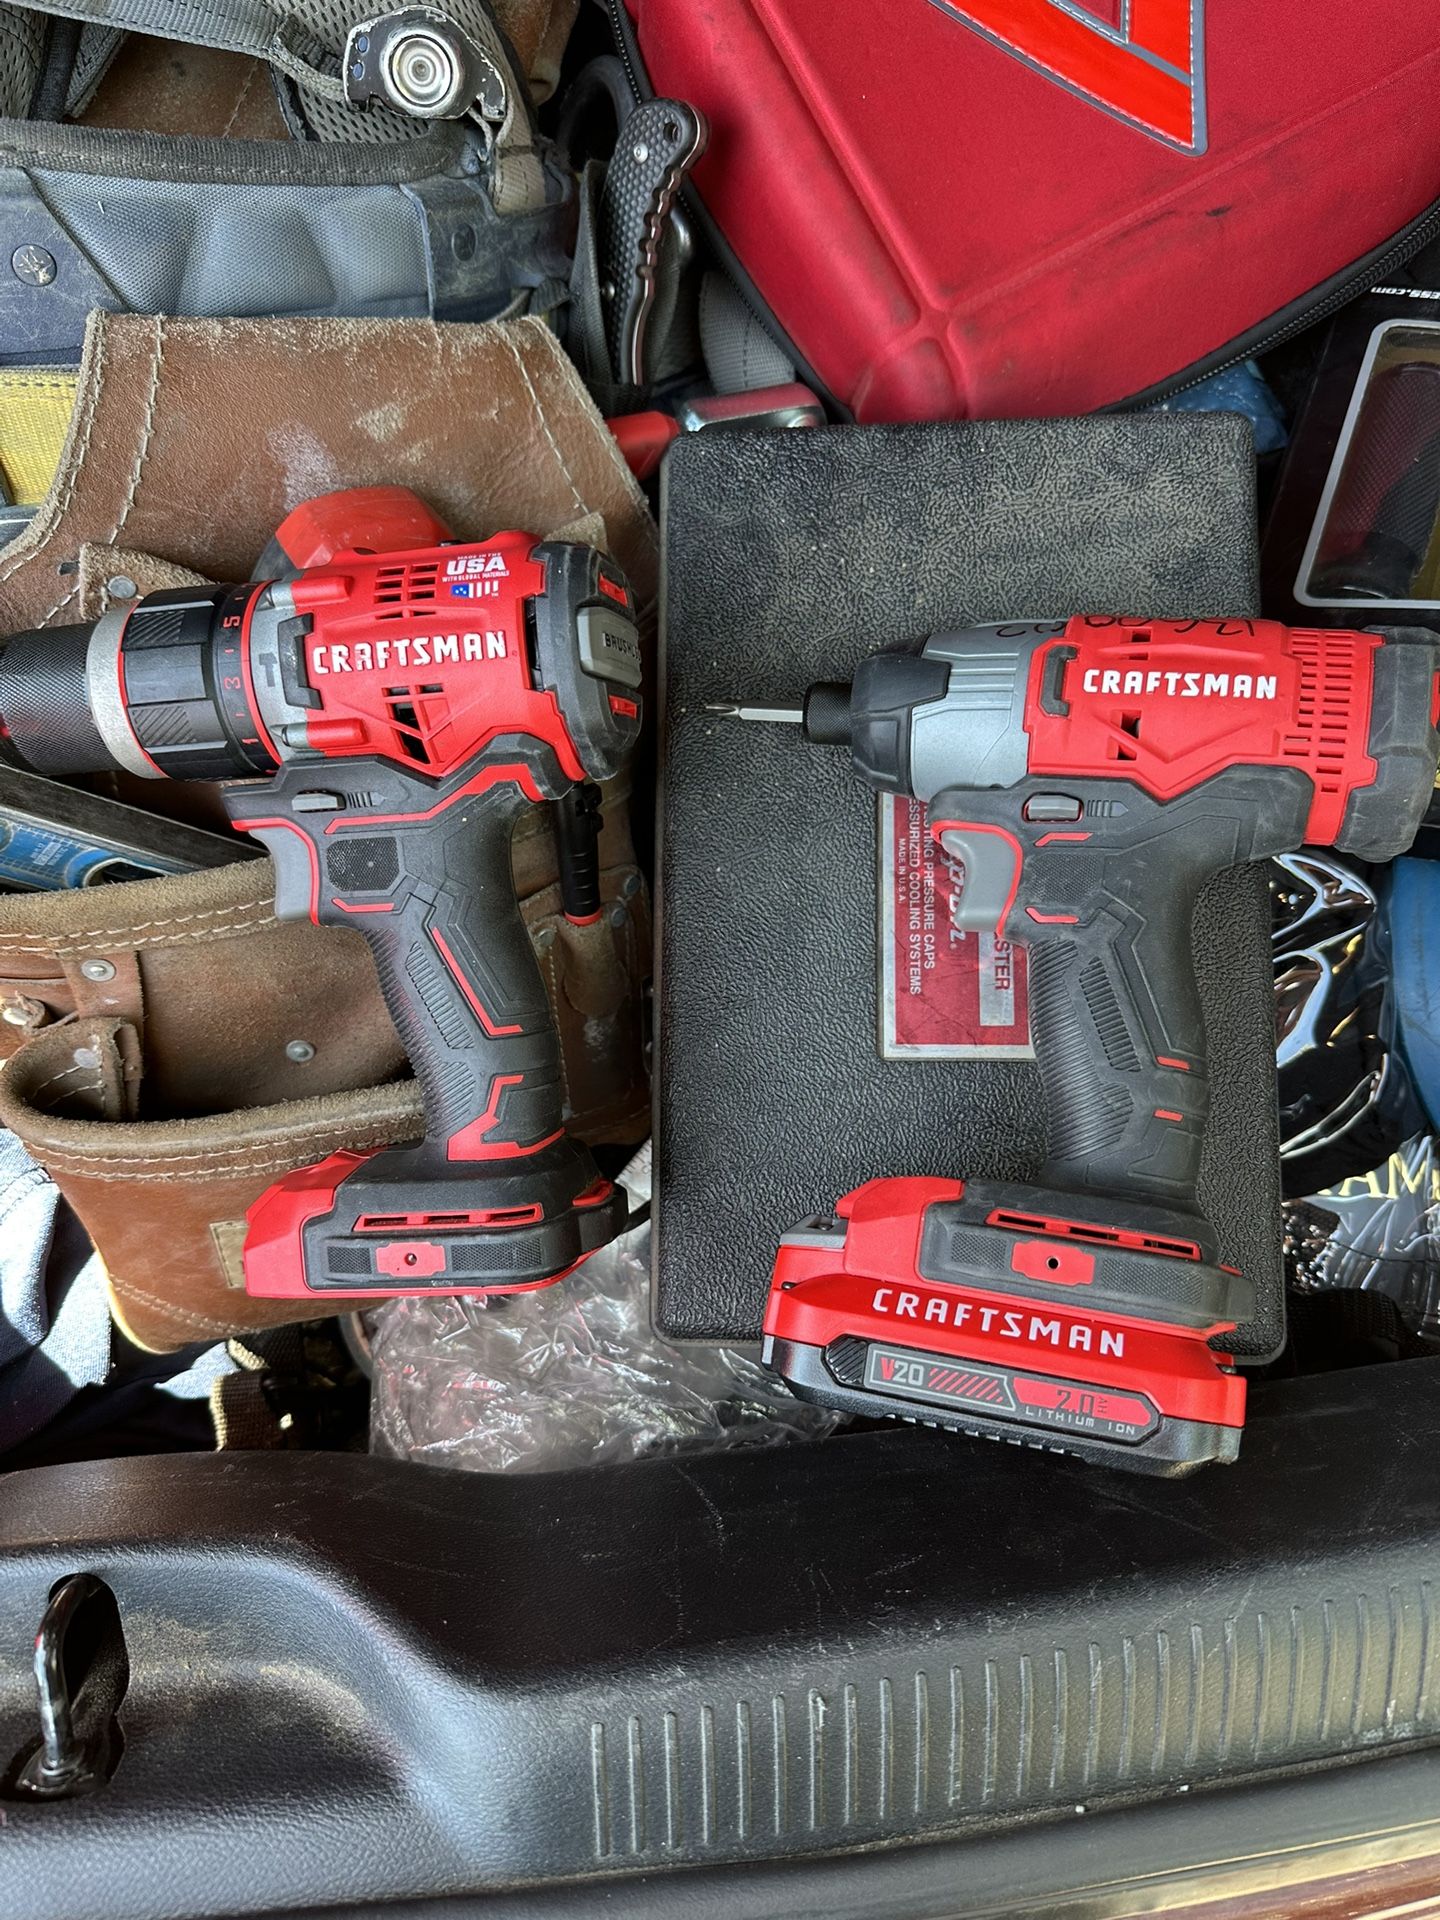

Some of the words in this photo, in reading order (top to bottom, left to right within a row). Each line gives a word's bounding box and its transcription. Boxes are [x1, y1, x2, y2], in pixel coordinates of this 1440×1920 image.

[441, 575, 458, 583] WITH
[458, 573, 481, 581] GLOBAL
[481, 570, 510, 579] MATERIALS
[446, 556, 507, 576] USA
[222, 615, 241, 628] 5
[312, 630, 508, 675] CRAFTSMAN
[223, 676, 241, 690] 3
[1082, 669, 1277, 700] CRAFTSMAN
[898, 838, 907, 864] MADE
[898, 865, 907, 875] IN
[909, 871, 921, 930] COOLING
[923, 861, 935, 930] PRESSURE
[909, 933, 922, 996] SYSTEMS
[923, 933, 936, 970] CAPS
[994, 933, 1011, 991] STER
[872, 1288, 1125, 1358] CRAFTSMAN
[880, 1356, 924, 1386] V20
[1056, 1389, 1095, 1417] 2.0
[1025, 1405, 1095, 1428] LITHIUM
[1107, 1421, 1136, 1435] ION
